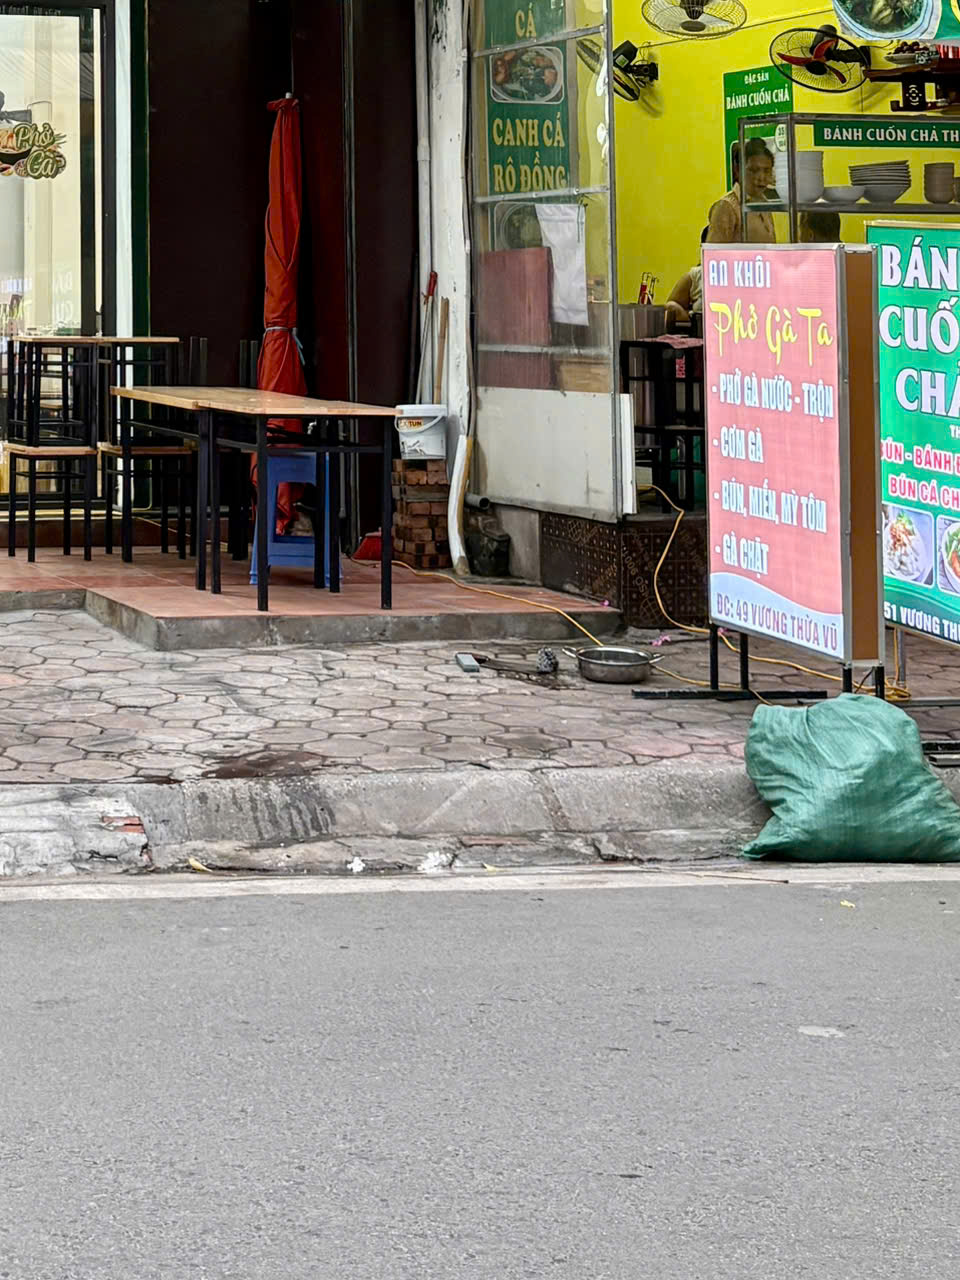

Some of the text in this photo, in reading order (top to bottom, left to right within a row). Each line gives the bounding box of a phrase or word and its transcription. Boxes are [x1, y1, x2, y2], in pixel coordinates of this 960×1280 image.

[514, 2, 537, 38] CÁ
[726, 83, 790, 110] BÁNH CUỐN CHẢ
[492, 111, 566, 148] CANH CÁ
[823, 123, 960, 143] BÁNH CUỐN CHẢ TH
[493, 151, 569, 193] RÔ ĐỒNG
[709, 255, 772, 289] AN KHÔI
[880, 235, 959, 291] BÁN
[709, 298, 834, 367] Phở Gà Ta
[879, 295, 960, 354] CUỐ
[719, 367, 742, 406] PHỞ
[743, 371, 760, 409] GÀ
[761, 374, 793, 413] NƯỚC
[802, 379, 835, 424] TRỘN
[720, 424, 765, 464] CƠM GÀ
[913, 444, 953, 475] BÁNH
[721, 477, 748, 518] BÚN,
[781, 489, 800, 527] MỲ
[800, 491, 828, 534] TÔM
[888, 473, 918, 501] BÚN
[918, 479, 940, 506] CÁ
[722, 530, 770, 579] GÀ CHẶT
[717, 592, 839, 652] ĐC: 49 VƯƠNG THỪA VŨ
[883, 600, 897, 622] 51
[899, 605, 941, 636] VƯƠNG
